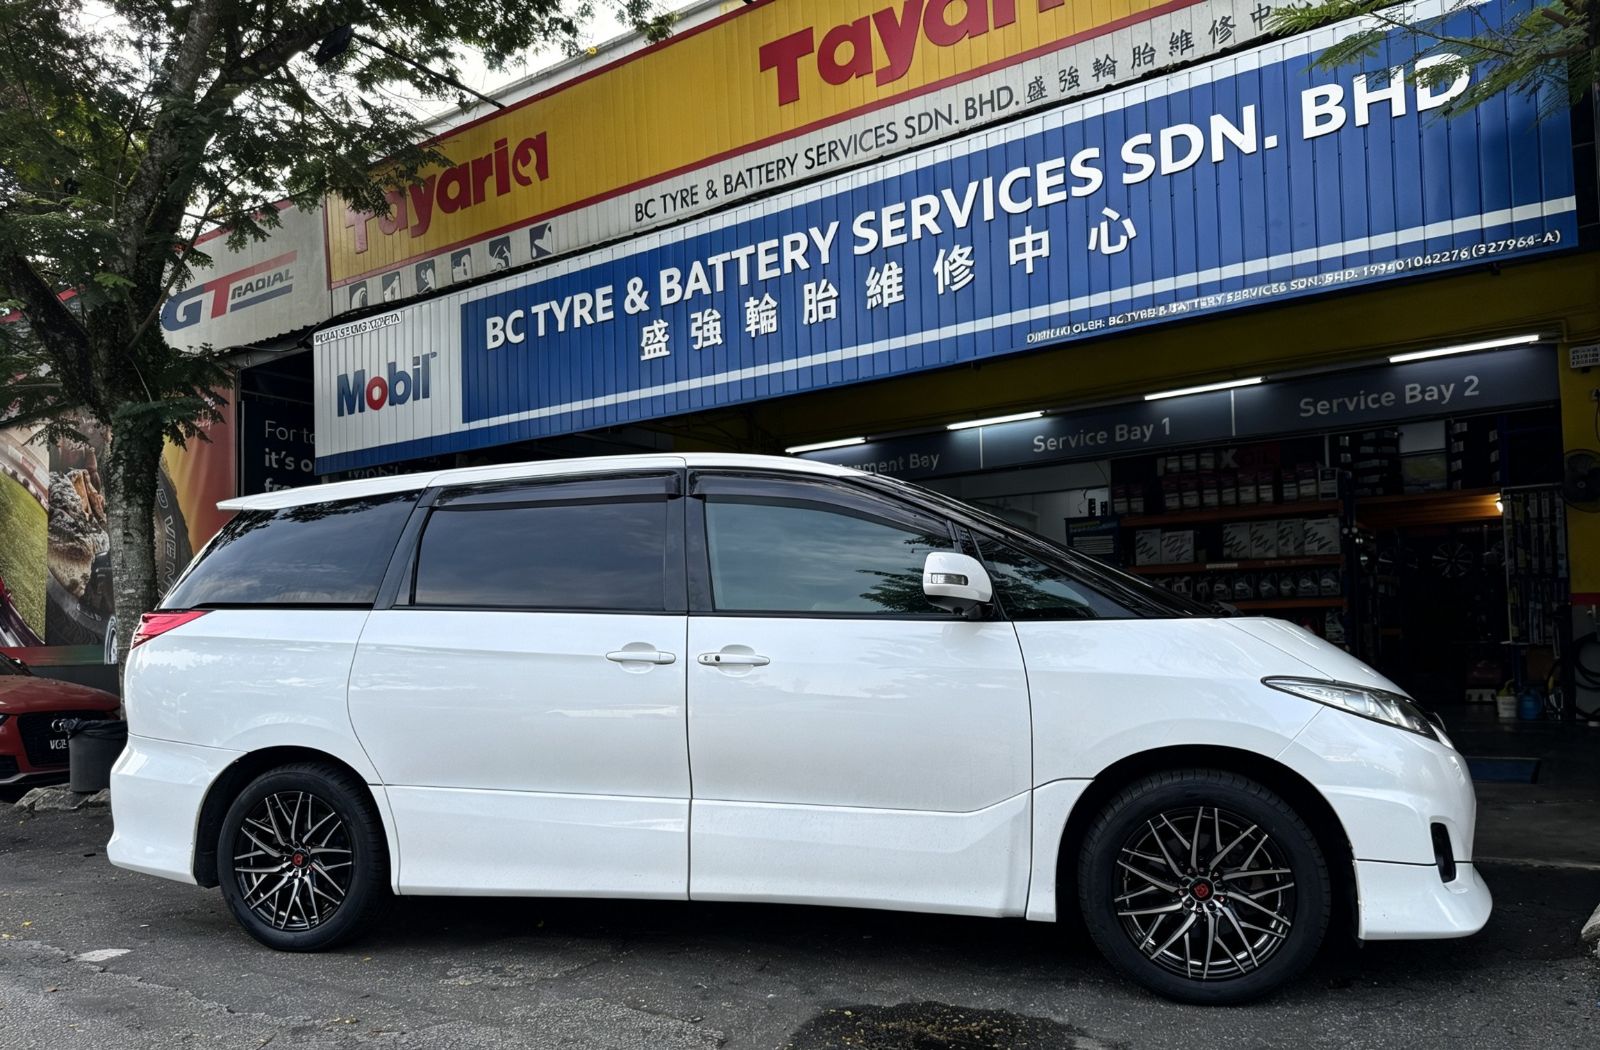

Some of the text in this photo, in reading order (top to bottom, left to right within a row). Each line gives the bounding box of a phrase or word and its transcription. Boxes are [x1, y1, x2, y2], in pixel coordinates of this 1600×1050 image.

[635, 196, 656, 222] BC
[660, 183, 699, 218] TYRE
[706, 178, 719, 199] &
[724, 152, 799, 195] BATTERY
[804, 121, 899, 170] SERVICES
[905, 103, 960, 140] SDN.
[965, 85, 1020, 121] BHD.
[486, 53, 1471, 350] BC TYRE & BATTERY SERVICES SDN. BHD
[231, 268, 294, 300] RADIAL
[640, 207, 1137, 361] 盛強輪胎維修中心
[337, 352, 431, 417] Mobil
[1300, 375, 1480, 418] Service Bay 2
[264, 419, 297, 443] For
[1032, 417, 1171, 453] Service Bay 1
[909, 453, 940, 471] Bay
